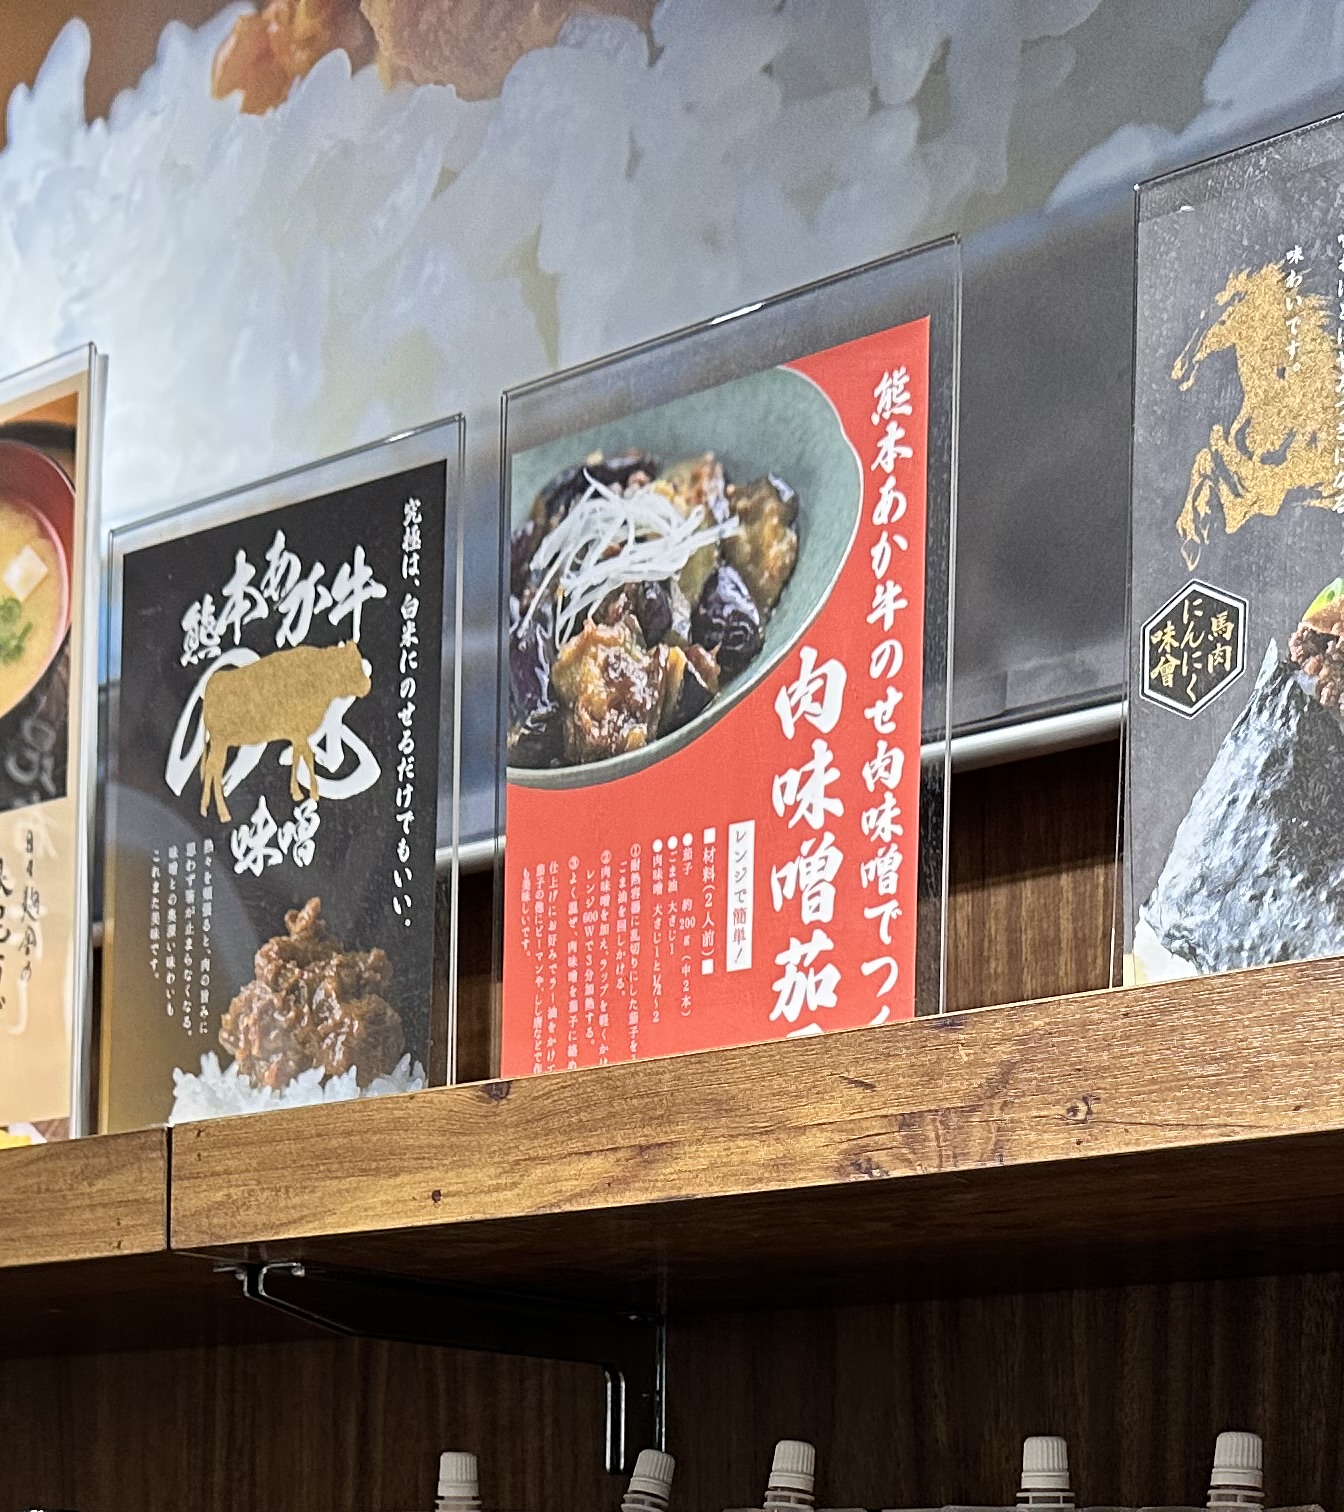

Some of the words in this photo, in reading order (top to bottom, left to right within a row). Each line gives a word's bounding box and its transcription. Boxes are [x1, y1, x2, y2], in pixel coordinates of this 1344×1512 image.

[1285, 244, 1305, 374] 味わいです。
[181, 529, 388, 667] 熊本あか牛
[1180, 598, 1205, 703] にんにく
[1207, 609, 1235, 674] 馬肉
[231, 795, 322, 877] 味噌
[652, 853, 664, 896] 肉味噌
[666, 851, 679, 894] ごま油
[769, 645, 849, 1039] 肉味噌茄
[628, 843, 642, 1061] ①耐熱容器に乱切りにした茄子を
